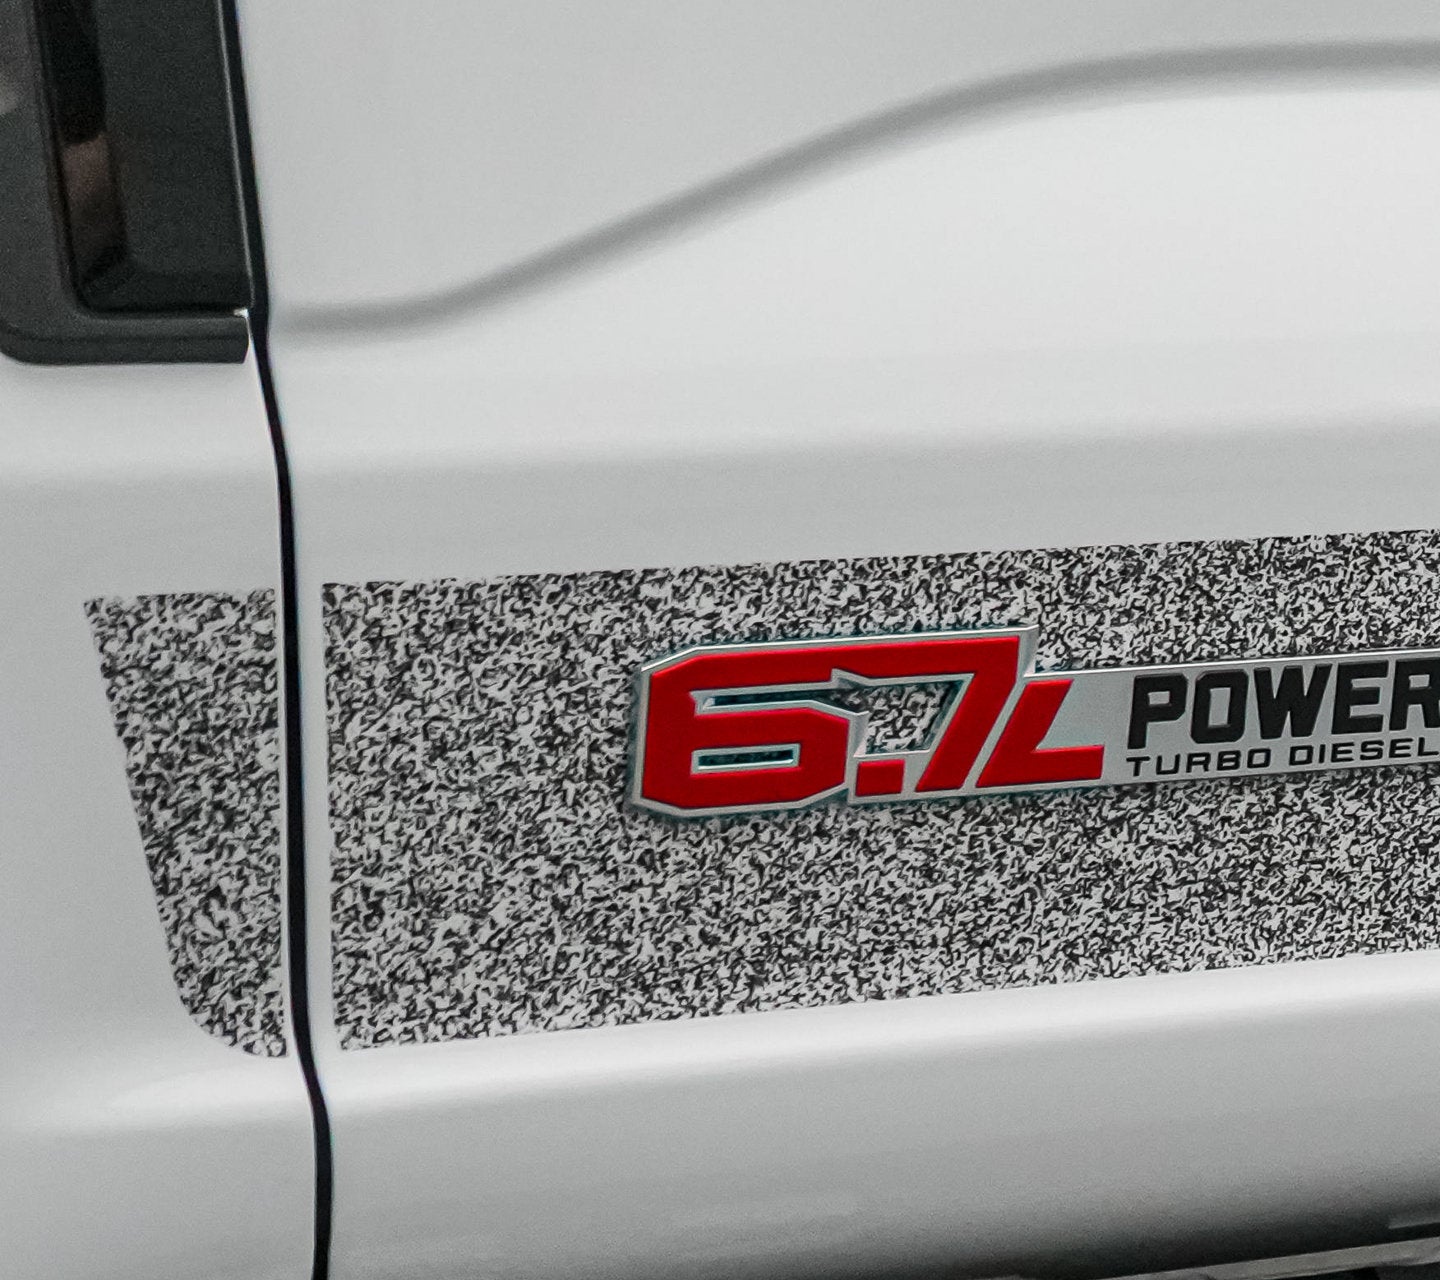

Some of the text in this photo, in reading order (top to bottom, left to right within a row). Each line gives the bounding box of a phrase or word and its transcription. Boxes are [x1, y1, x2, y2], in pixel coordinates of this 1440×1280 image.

[641, 635, 1105, 810] 6.7L
[1126, 737, 1440, 777] TURBO DIESEL
